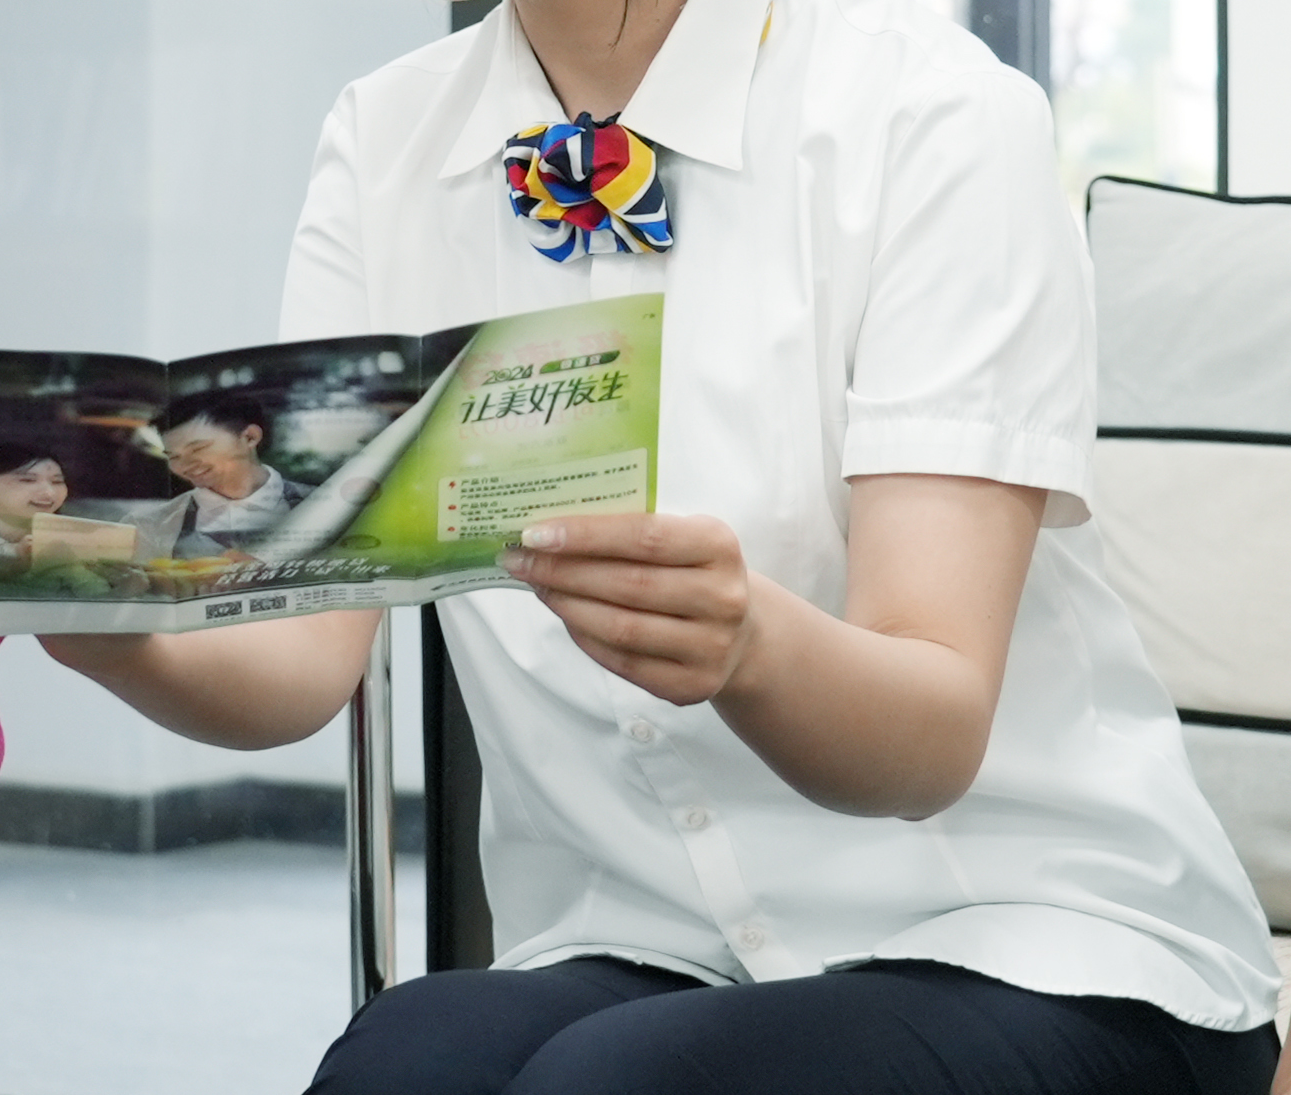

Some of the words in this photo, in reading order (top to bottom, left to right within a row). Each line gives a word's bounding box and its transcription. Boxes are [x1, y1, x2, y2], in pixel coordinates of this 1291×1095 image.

[461, 370, 629, 424] 让美好发生
